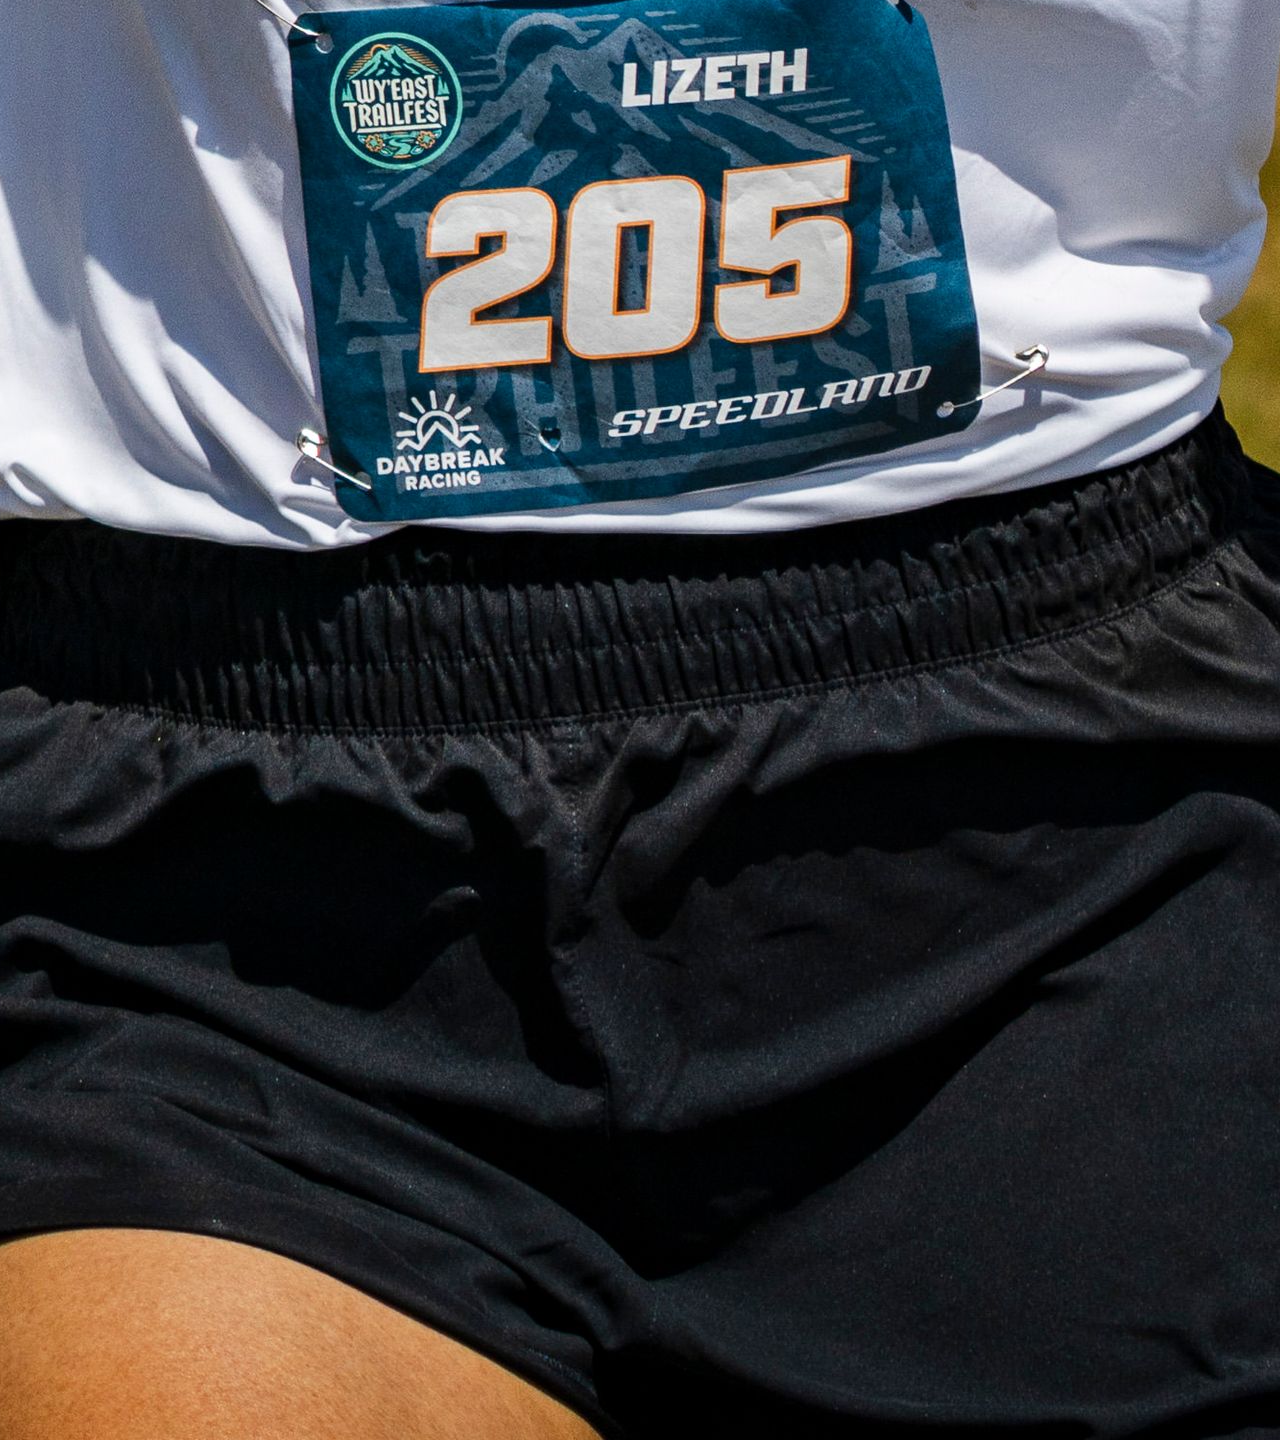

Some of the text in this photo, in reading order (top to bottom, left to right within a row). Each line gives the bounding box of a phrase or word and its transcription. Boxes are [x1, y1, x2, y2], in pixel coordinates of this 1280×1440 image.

[352, 74, 436, 105] WY'EAST
[621, 47, 808, 108] LIZETH
[342, 95, 450, 133] TRAILFEST
[418, 154, 853, 374] 205
[608, 365, 932, 438] SPEEDLAND
[376, 447, 506, 476] DAYBREAK
[405, 470, 481, 491] RACING
